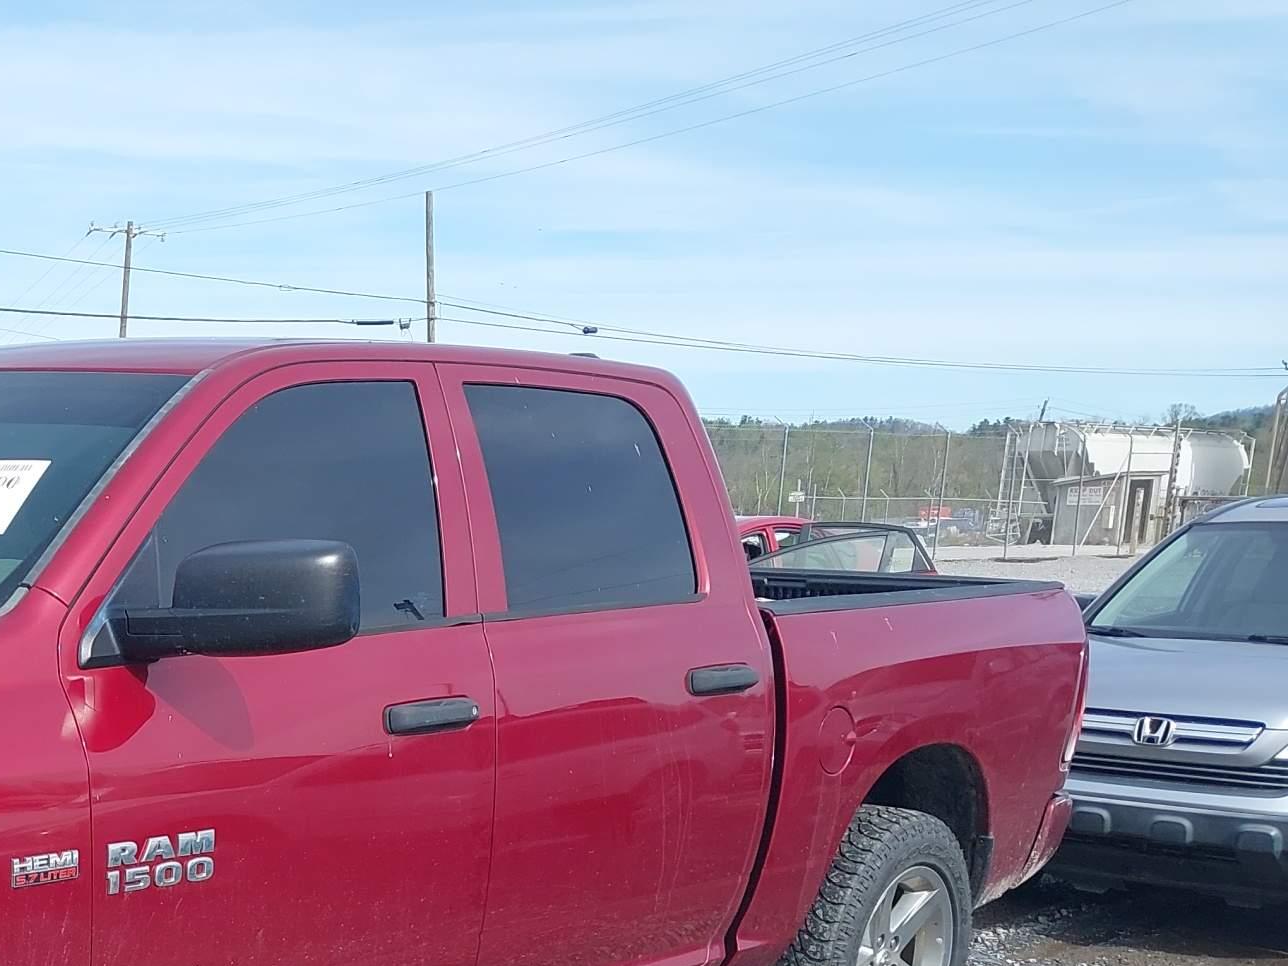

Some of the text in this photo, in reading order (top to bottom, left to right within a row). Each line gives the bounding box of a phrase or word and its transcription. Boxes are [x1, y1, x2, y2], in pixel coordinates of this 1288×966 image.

[13, 849, 80, 874] HEMI
[106, 829, 216, 868] RAM
[15, 867, 78, 886] 5.7 LITER
[106, 856, 215, 896] 1500
